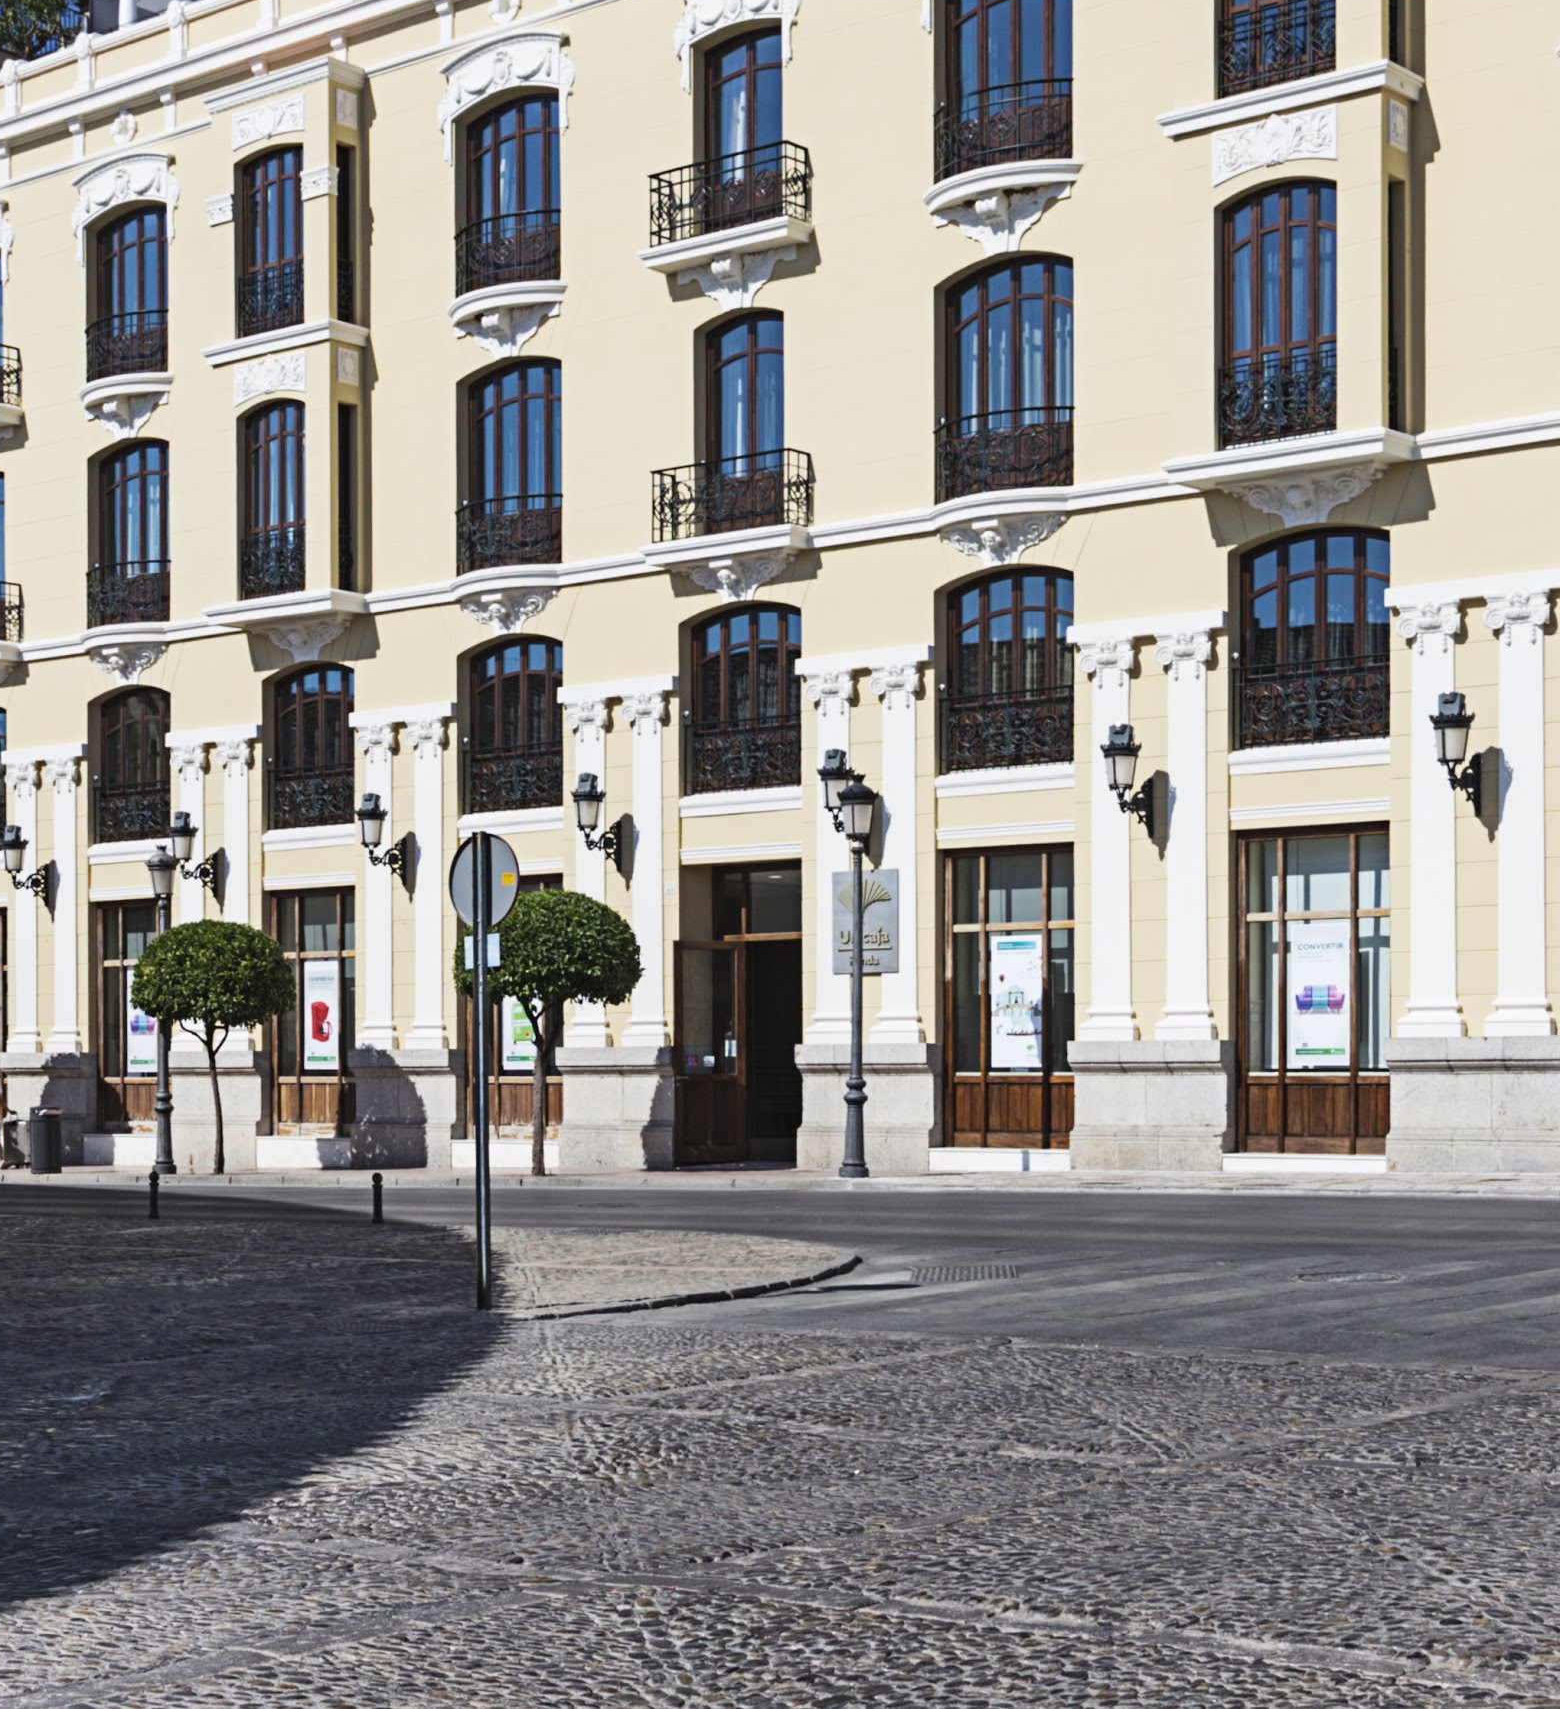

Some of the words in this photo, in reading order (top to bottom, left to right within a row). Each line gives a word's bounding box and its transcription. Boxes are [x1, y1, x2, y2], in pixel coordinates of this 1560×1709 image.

[841, 927, 890, 946] Ucaja
[1297, 942, 1344, 951] CONVERTIR
[850, 955, 880, 966] Rnda
